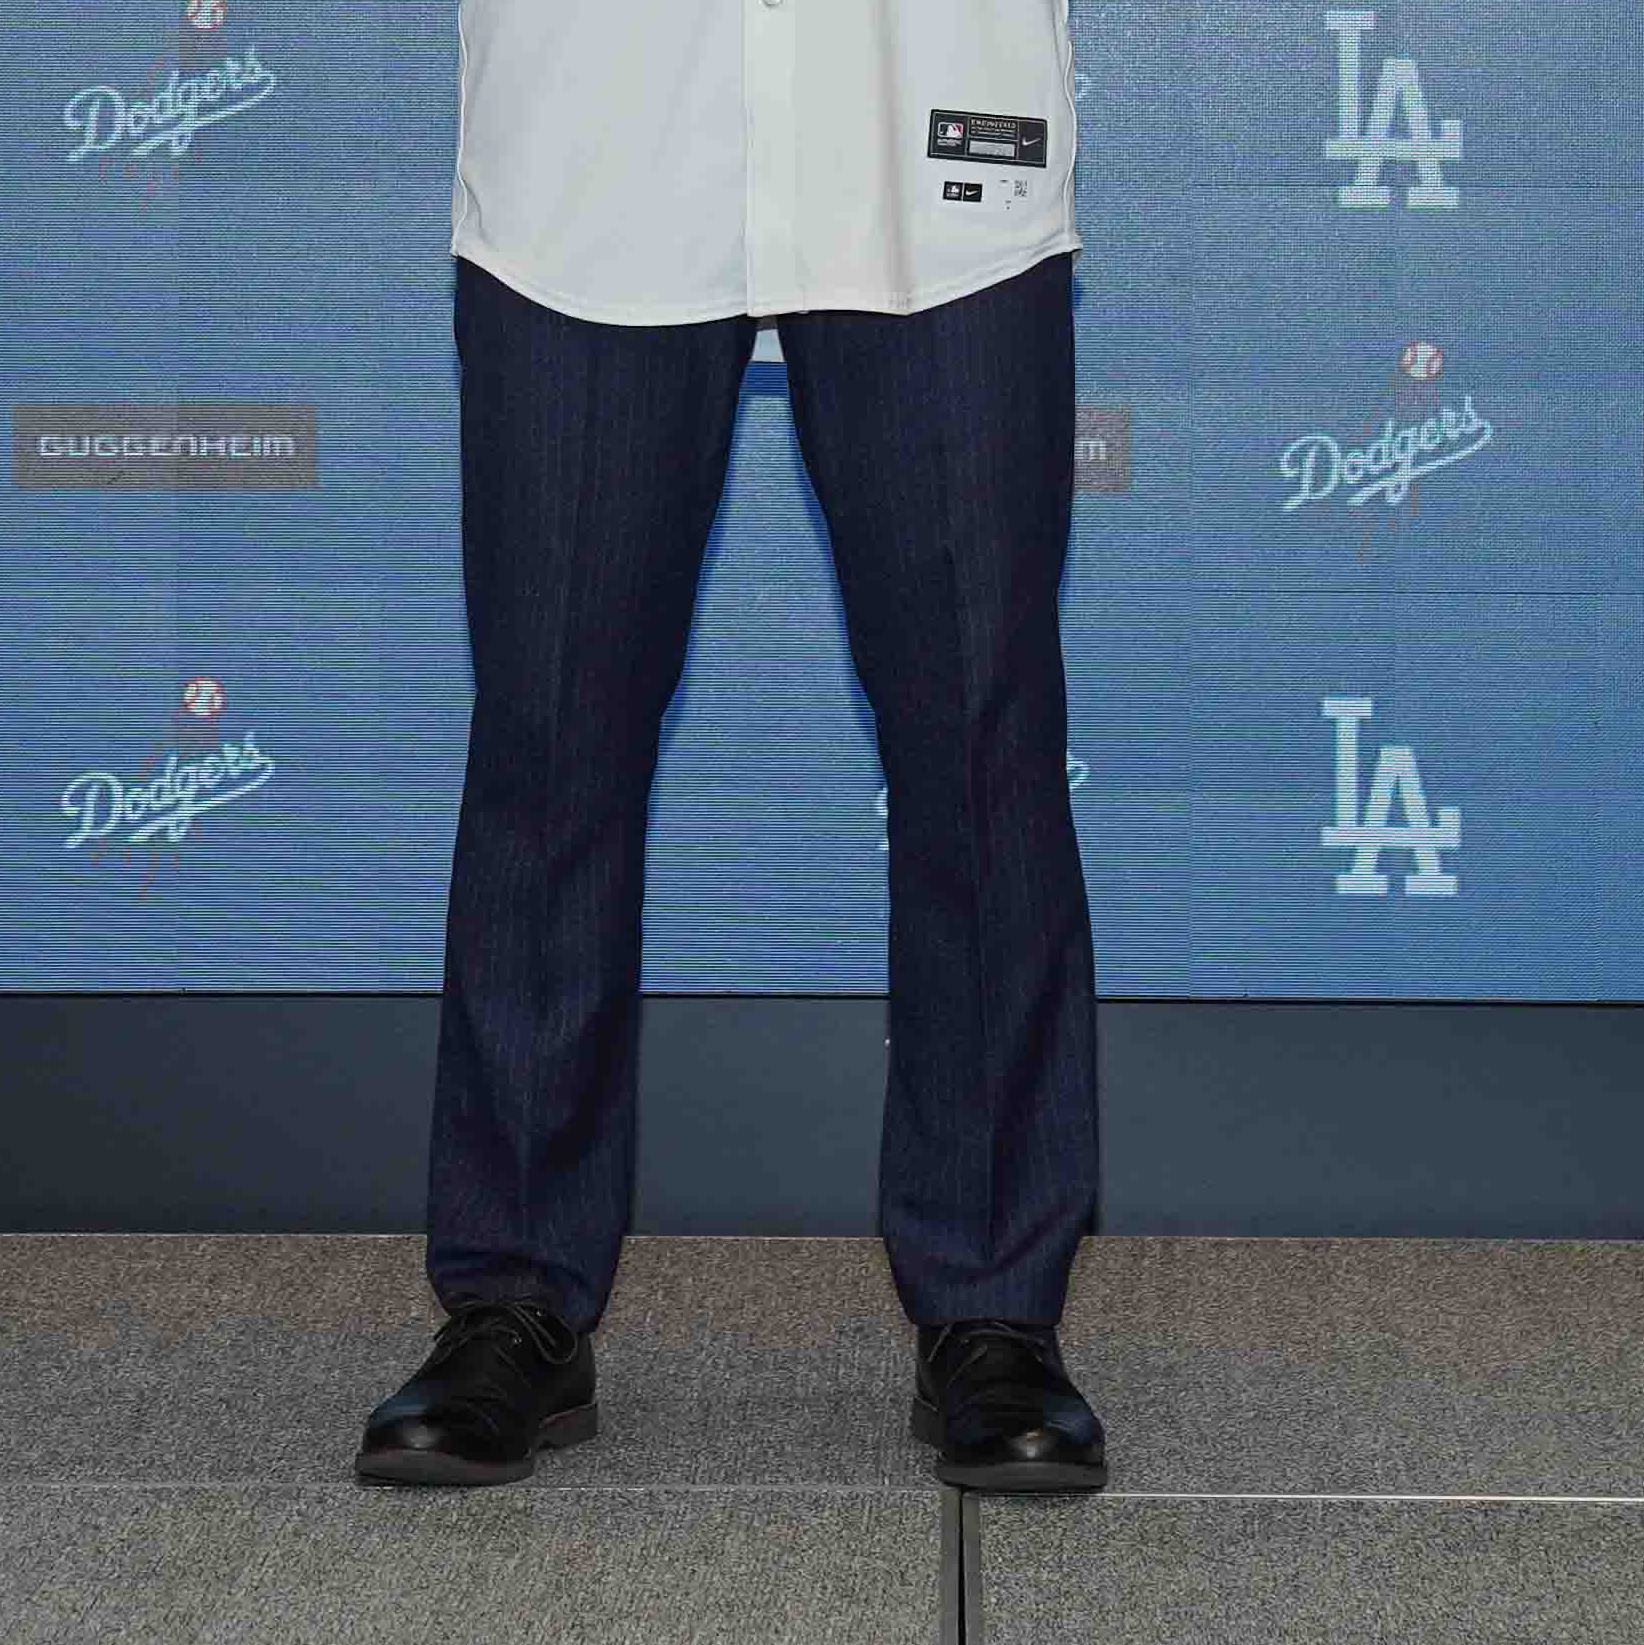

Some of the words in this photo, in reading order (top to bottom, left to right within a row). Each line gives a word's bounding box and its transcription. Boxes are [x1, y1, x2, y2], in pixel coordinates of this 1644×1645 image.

[63, 48, 275, 163] Dodgers
[1325, 10, 1463, 209] LA
[37, 432, 295, 459] GUGGENHEIM
[1280, 394, 1493, 511] Dodgers
[60, 732, 274, 850] Dodgers
[1320, 697, 1462, 897] LA
